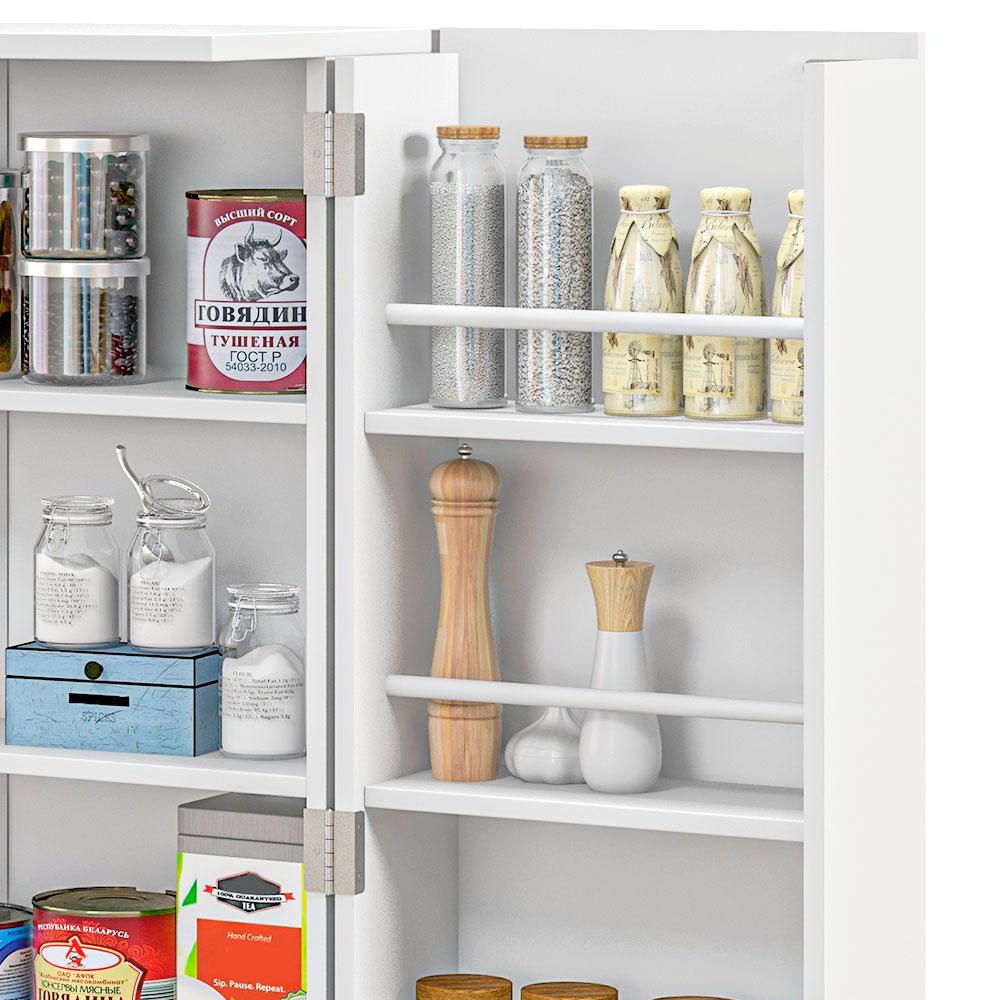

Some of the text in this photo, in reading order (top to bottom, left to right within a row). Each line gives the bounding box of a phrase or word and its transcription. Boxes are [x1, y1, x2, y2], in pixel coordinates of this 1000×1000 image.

[214, 208, 298, 227] ВЫСШИЙ СОРТ
[211, 335, 299, 348] ТУШЕНАЯ
[230, 351, 266, 362] ГОСТ
[226, 362, 287, 372] 54033-2010
[242, 902, 255, 910] TEA
[82, 926, 130, 939] БЕЛАРУСЬ
[227, 932, 272, 942] Hand Crafted
[80, 985, 121, 994] МЯСНЫЕ
[213, 979, 286, 993] Sip. Pause. Repeat.
